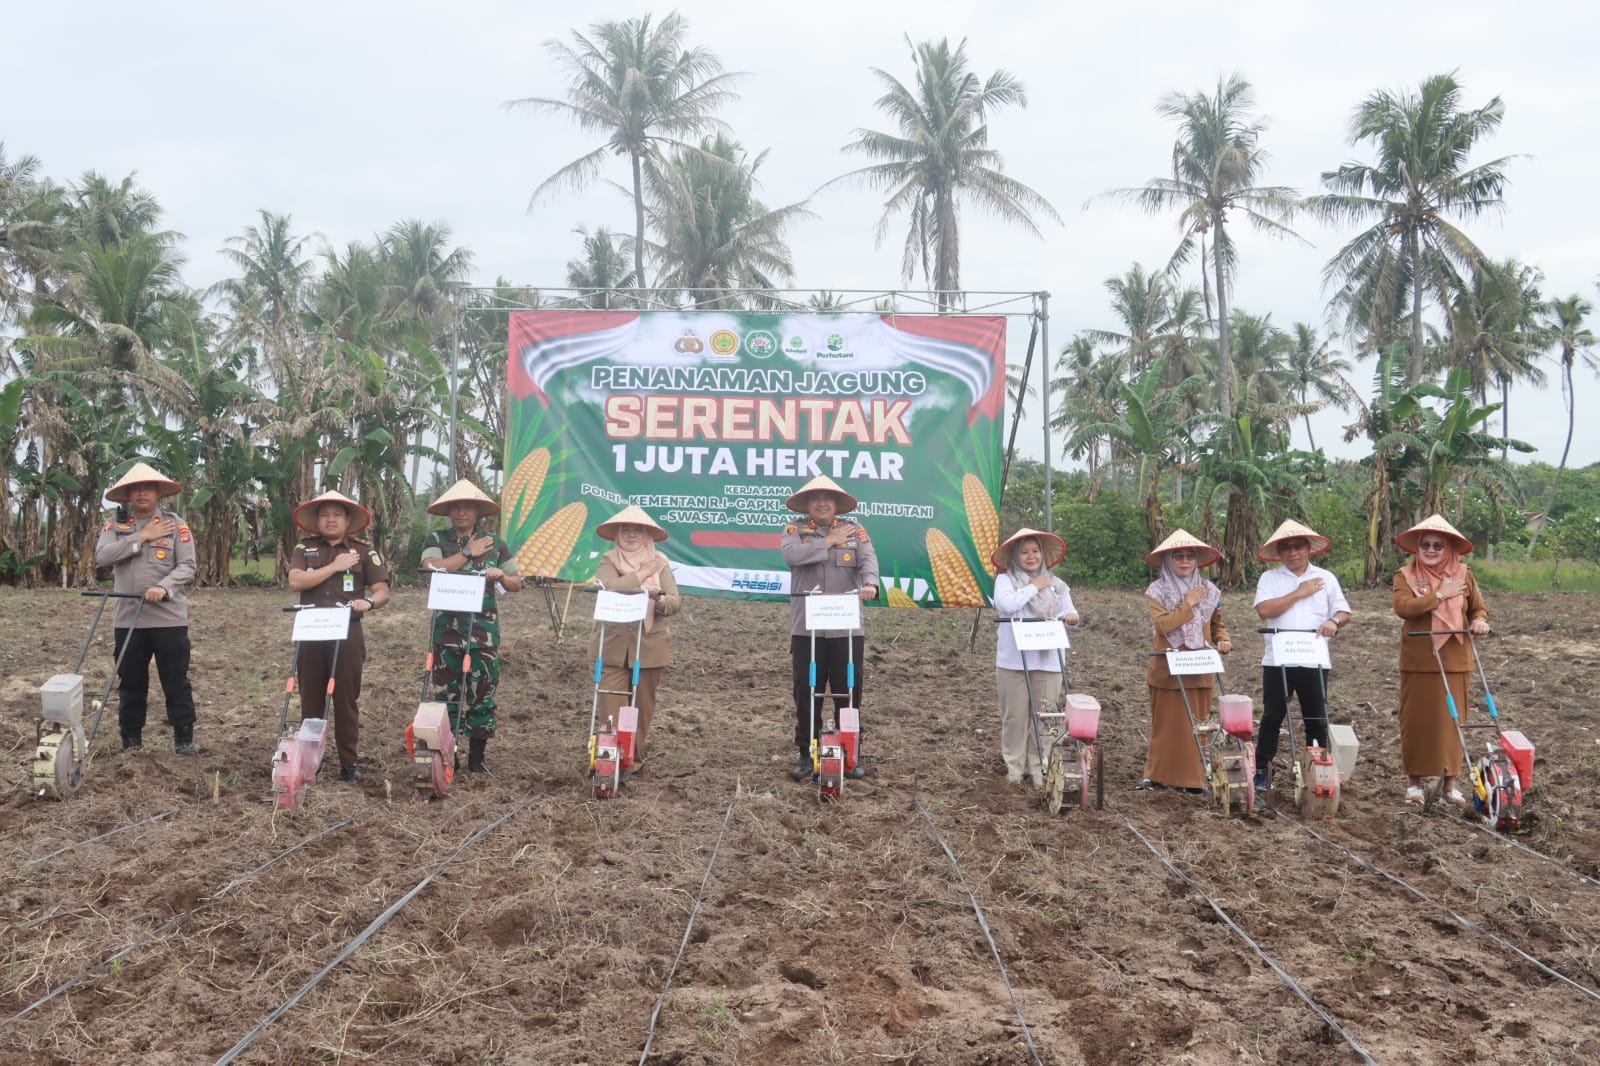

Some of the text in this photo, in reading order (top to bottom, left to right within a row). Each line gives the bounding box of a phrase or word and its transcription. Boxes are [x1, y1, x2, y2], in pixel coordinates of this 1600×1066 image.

[592, 365, 926, 395] PENANAMAN JAGUNG
[605, 395, 912, 446] SERENTAK
[612, 444, 905, 480] 1 JUTA HEKTAR
[581, 483, 621, 504] POLRI
[629, 495, 708, 508] KEMENTAN
[735, 498, 780, 511] GAPKI
[872, 502, 934, 519] INHUTANI
[724, 485, 793, 497] KERJA SAMA
[667, 510, 728, 524] SWASTA
[731, 580, 783, 591] PRESISI
